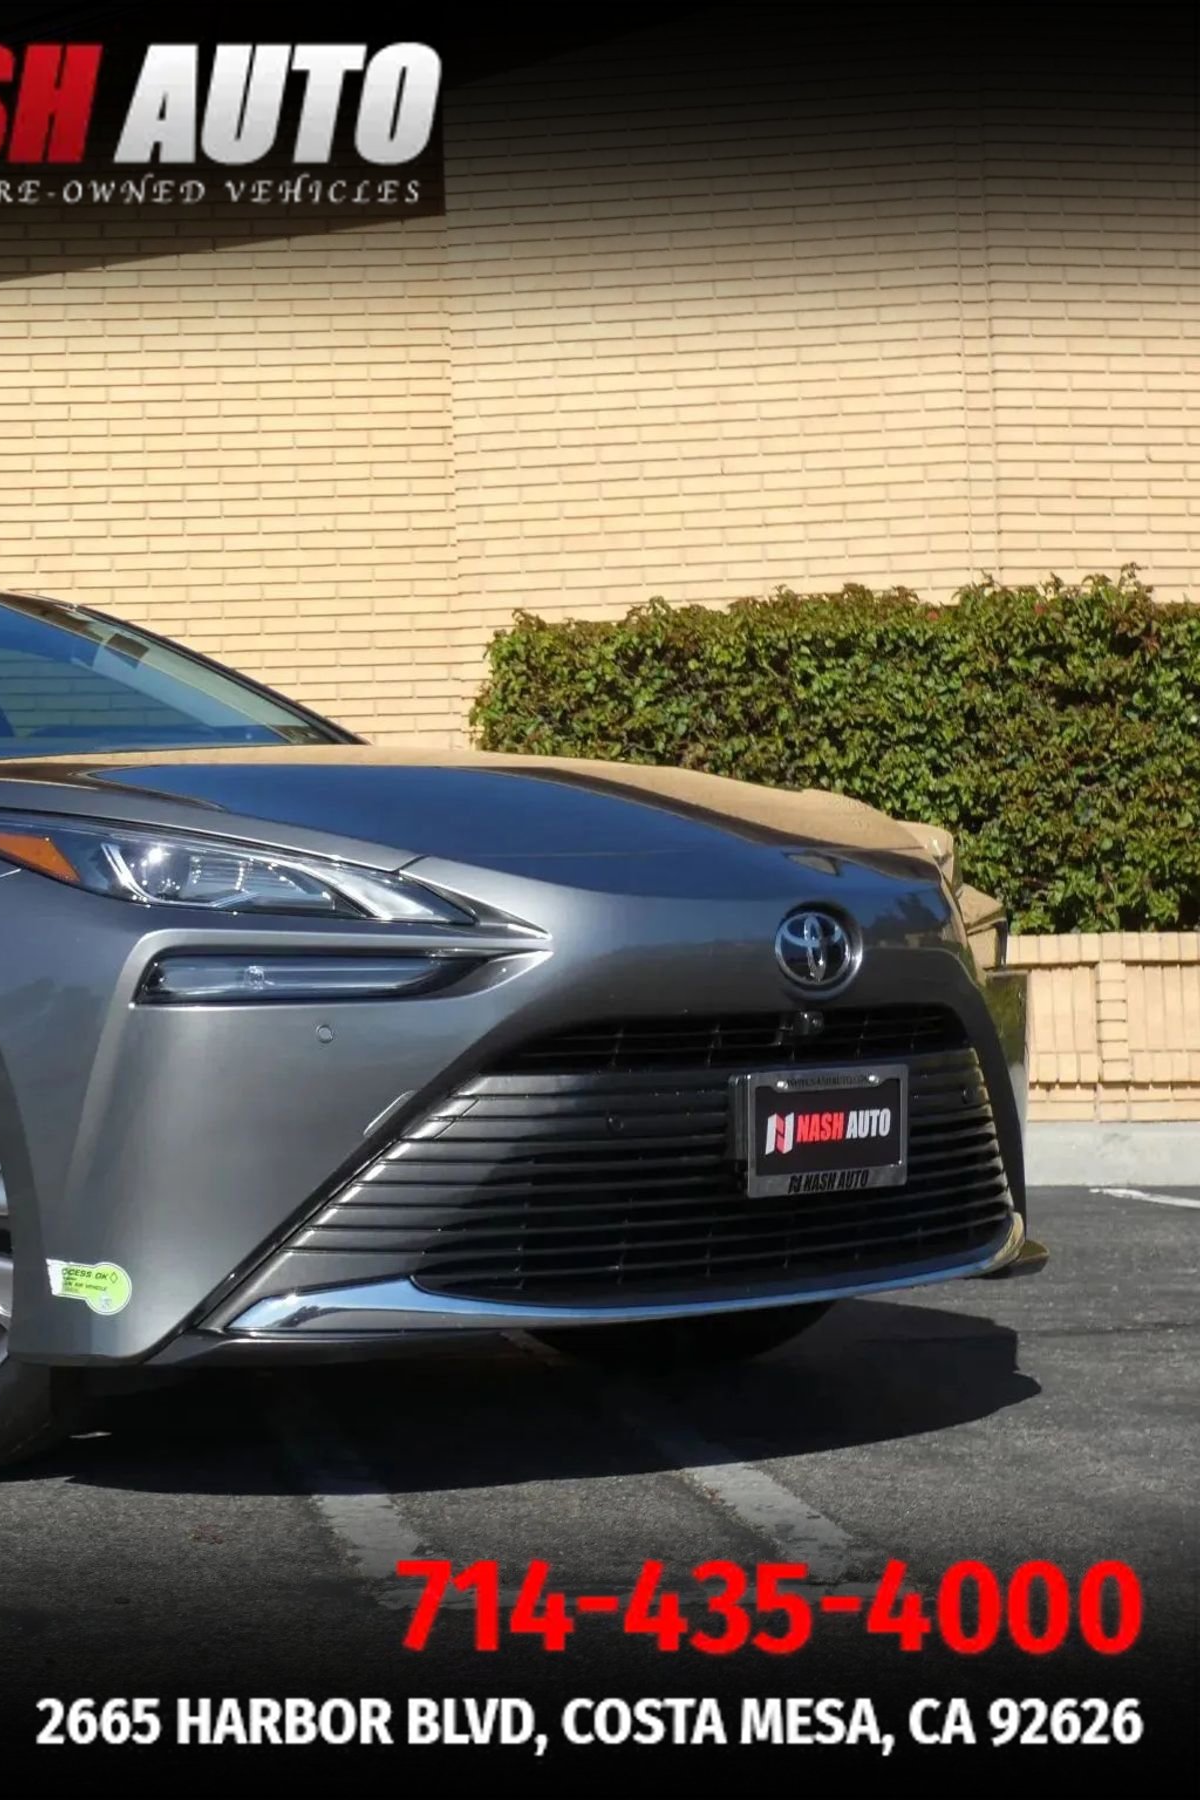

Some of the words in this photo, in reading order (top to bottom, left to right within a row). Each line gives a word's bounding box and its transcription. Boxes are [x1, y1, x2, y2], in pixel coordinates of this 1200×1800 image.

[796, 1112, 844, 1143] NASH
[846, 1108, 891, 1139] AUTO
[803, 1172, 837, 1193] NASH
[838, 1169, 869, 1189] AUTO
